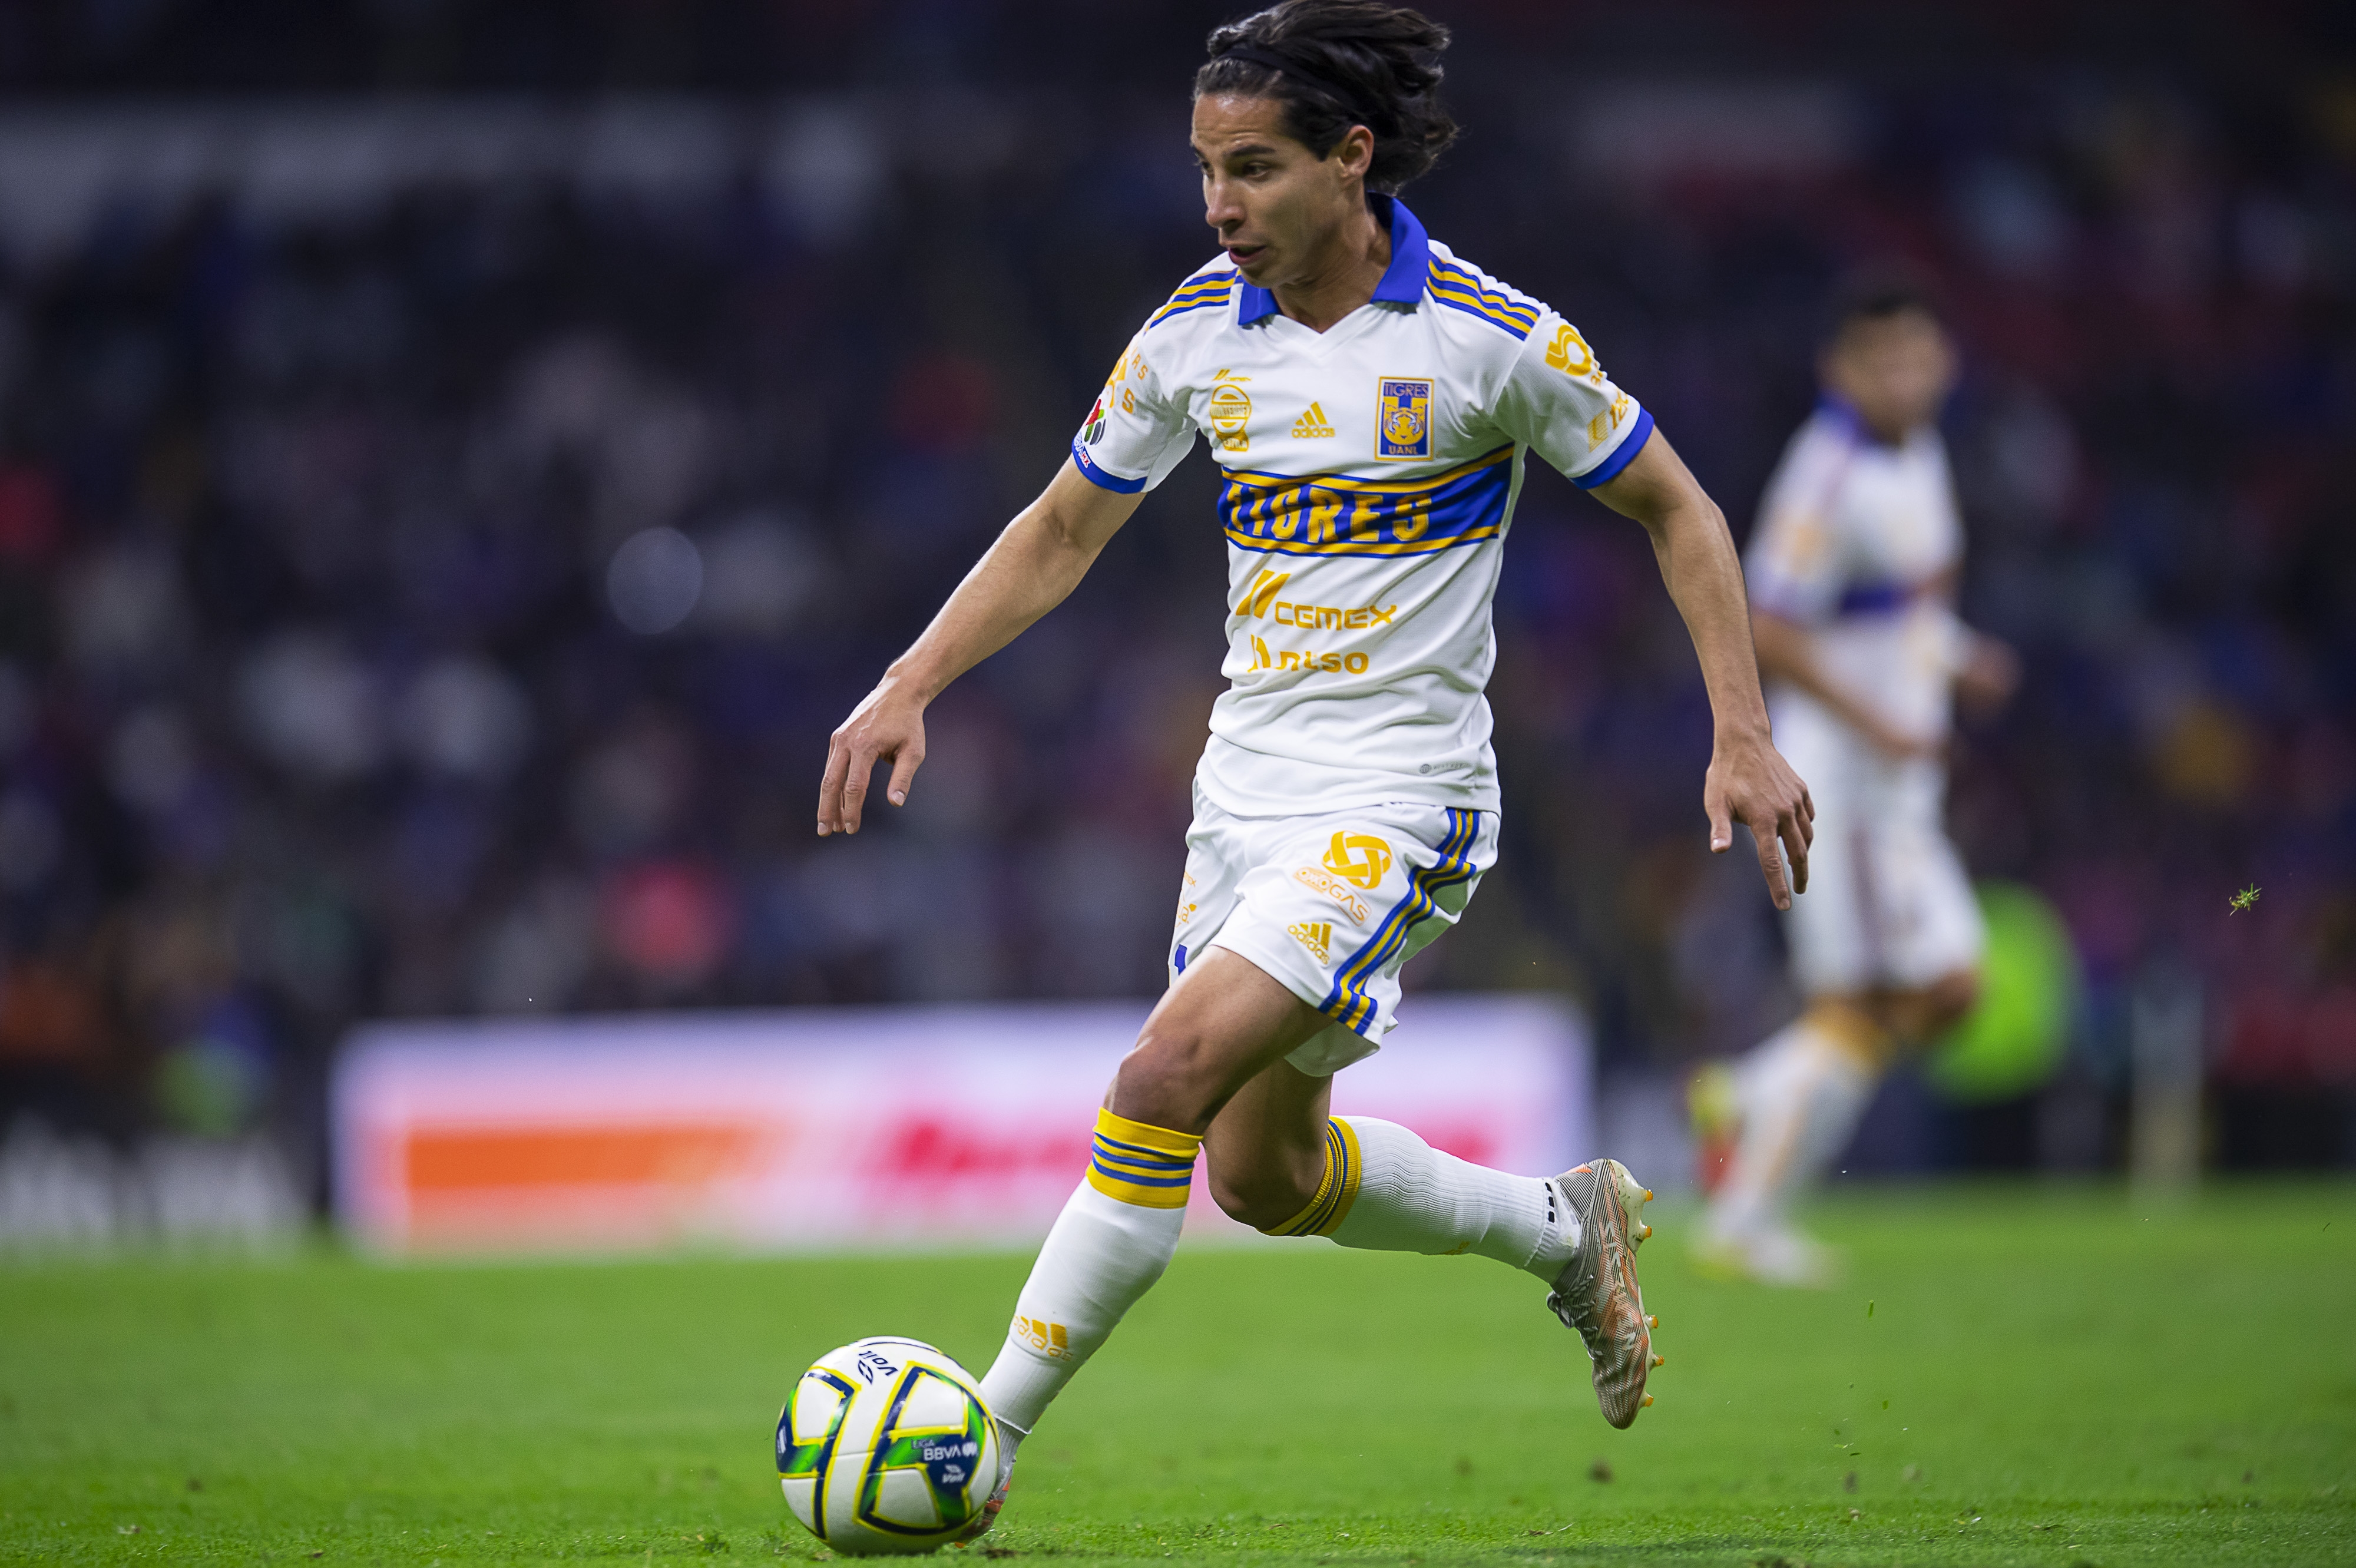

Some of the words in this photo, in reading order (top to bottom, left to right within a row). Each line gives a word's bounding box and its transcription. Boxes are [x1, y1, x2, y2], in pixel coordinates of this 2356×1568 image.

[1385, 383, 1428, 397] TIGRES
[1292, 426, 1335, 438] adidas
[1388, 445, 1418, 455] UANL
[1275, 601, 1397, 630] CEMEX
[1329, 884, 1368, 921] GAS
[1288, 924, 1329, 964] adidas
[923, 1445, 961, 1461] BBVA
